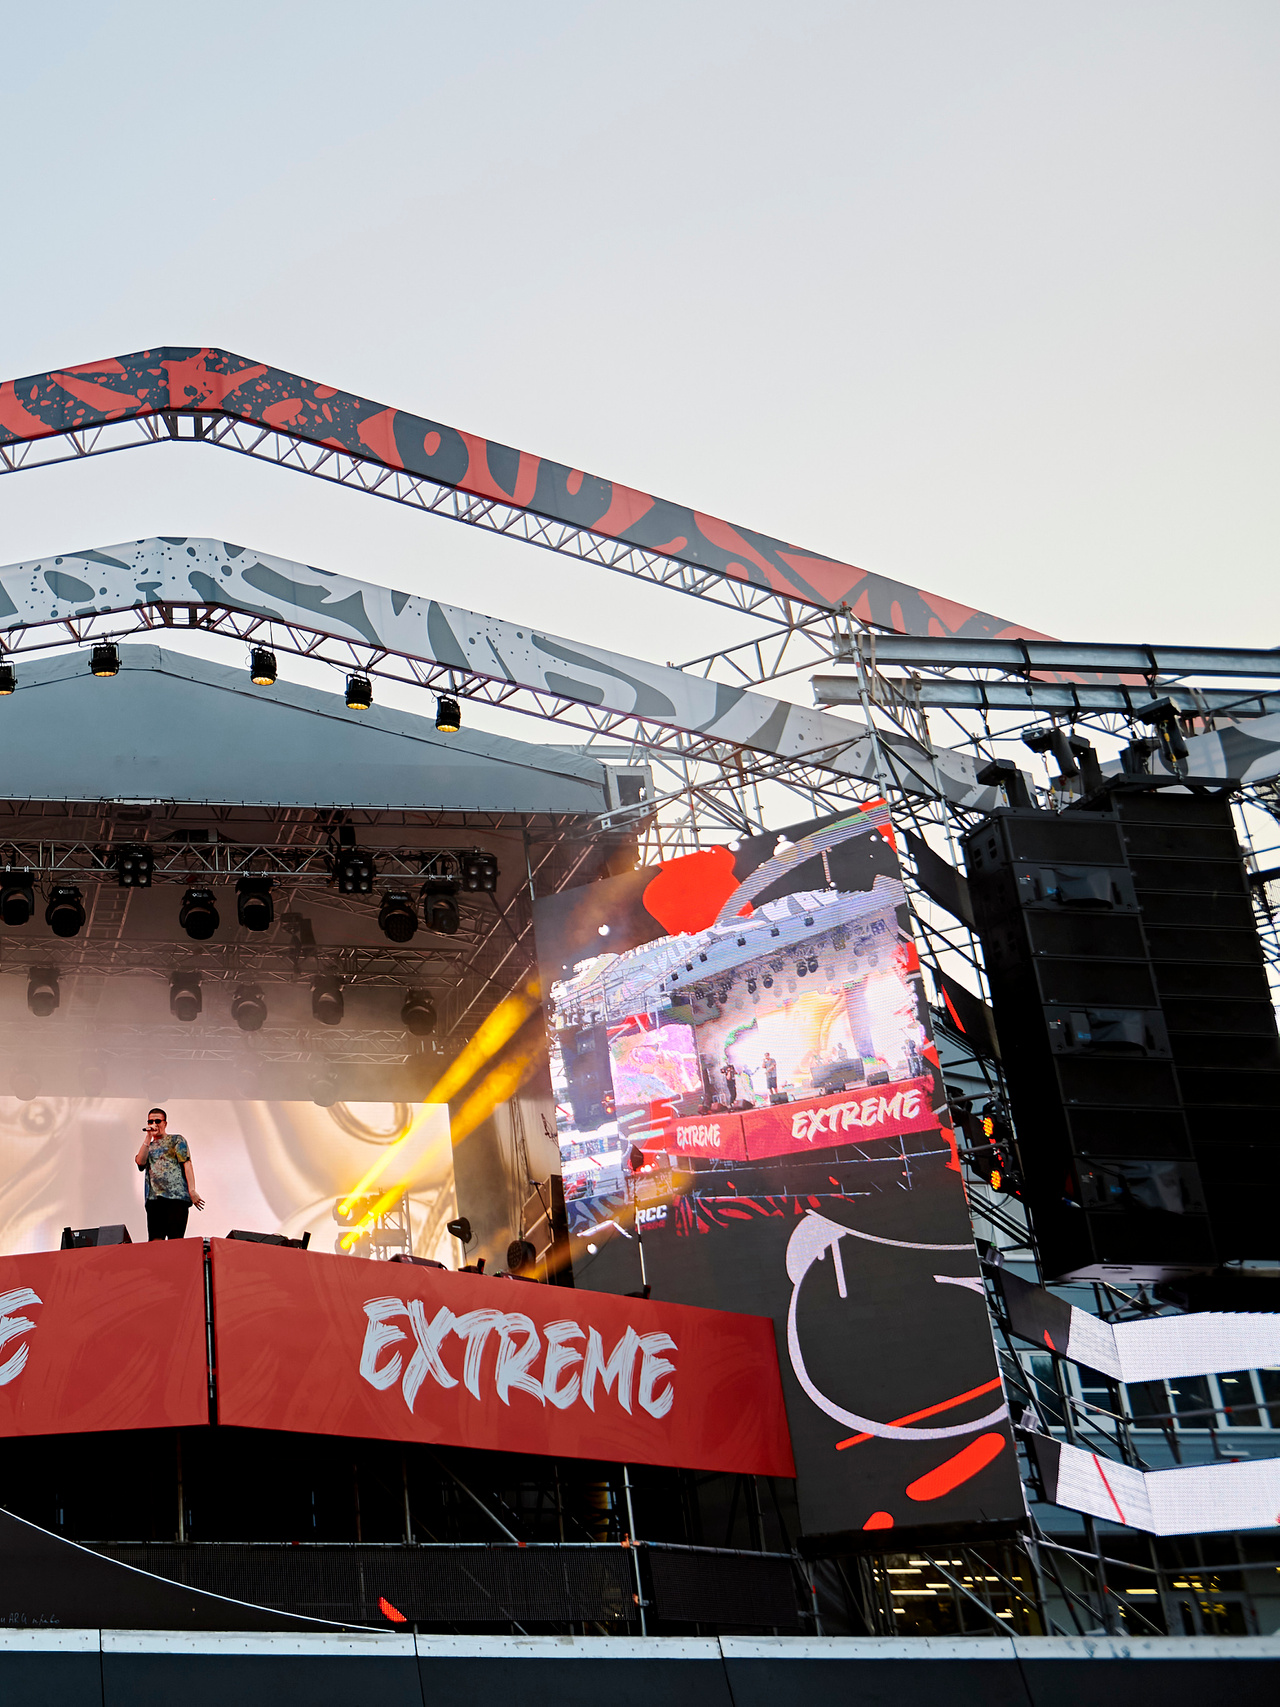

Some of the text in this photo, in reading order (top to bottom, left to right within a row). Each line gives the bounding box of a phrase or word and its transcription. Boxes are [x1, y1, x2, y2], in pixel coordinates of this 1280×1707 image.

[791, 1088, 922, 1143] EXTREME
[676, 1123, 721, 1150] EXTREME
[635, 1204, 668, 1224] RCC
[359, 1295, 680, 1420] EXTREME
